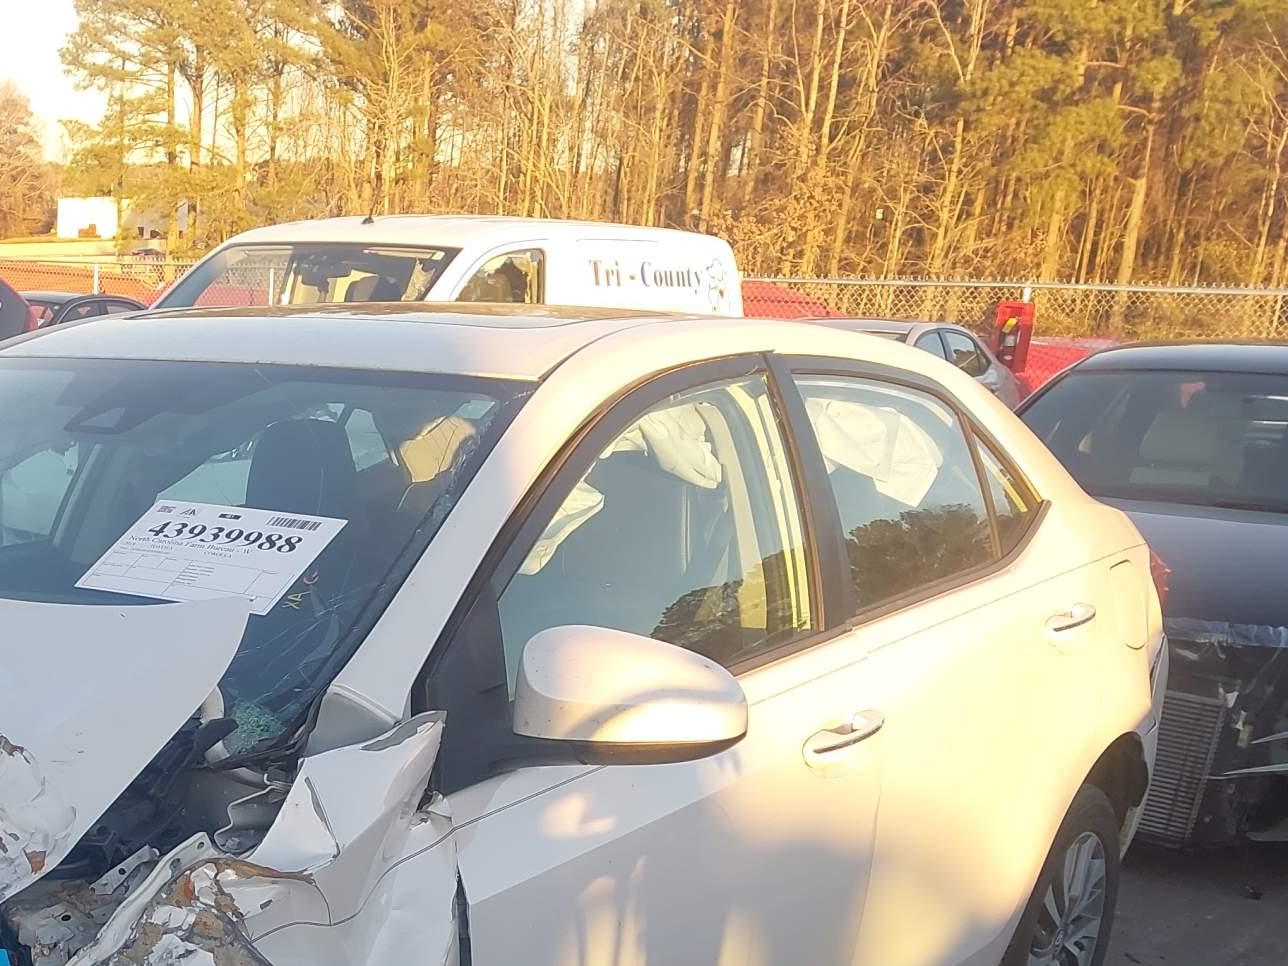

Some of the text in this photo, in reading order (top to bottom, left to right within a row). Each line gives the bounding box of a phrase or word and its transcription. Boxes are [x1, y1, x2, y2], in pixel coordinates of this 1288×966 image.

[589, 259, 623, 287] Tri
[640, 261, 703, 295] County
[128, 535, 152, 543] North
[148, 520, 304, 554] 43939988
